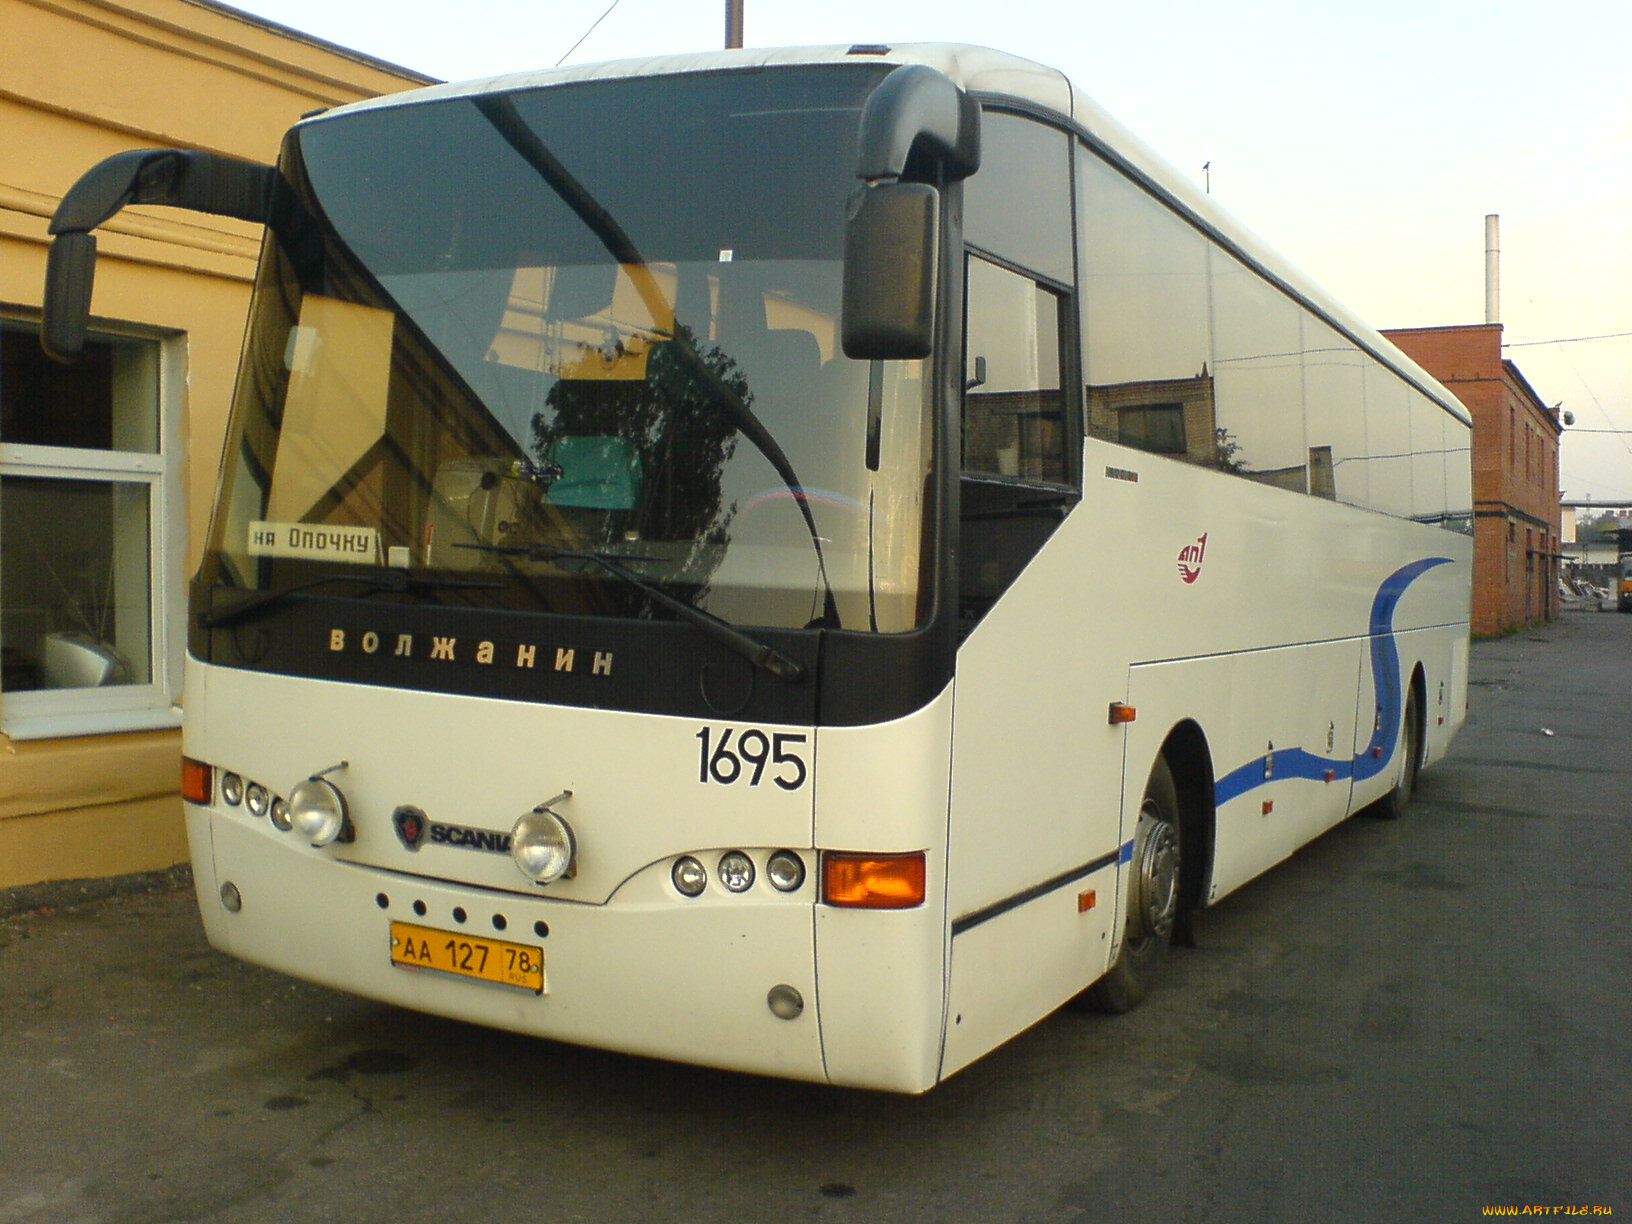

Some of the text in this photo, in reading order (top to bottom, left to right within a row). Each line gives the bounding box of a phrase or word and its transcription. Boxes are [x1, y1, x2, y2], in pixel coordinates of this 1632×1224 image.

[696, 726, 807, 791] 1695
[445, 939, 489, 973] 127
[505, 948, 531, 973] 78
[508, 973, 529, 984] RUS
